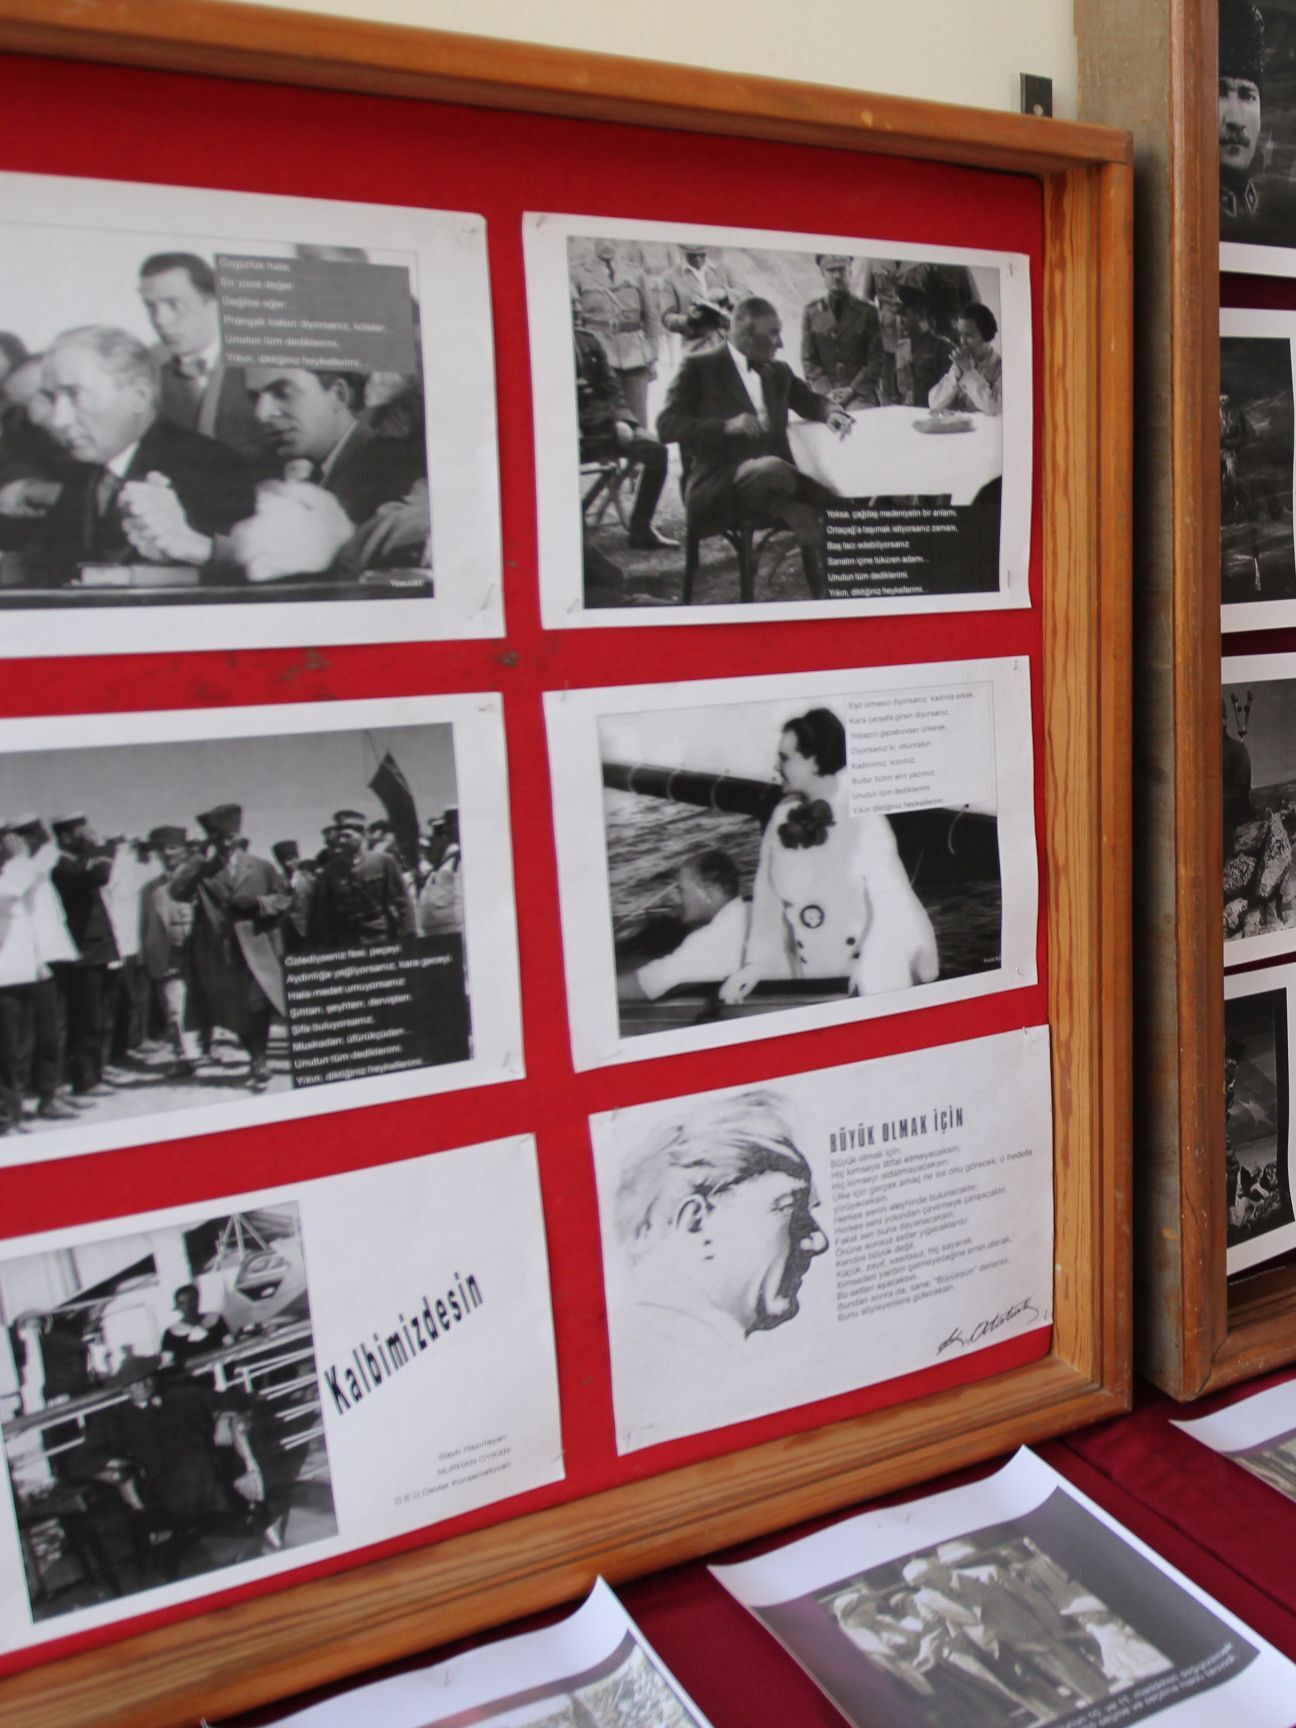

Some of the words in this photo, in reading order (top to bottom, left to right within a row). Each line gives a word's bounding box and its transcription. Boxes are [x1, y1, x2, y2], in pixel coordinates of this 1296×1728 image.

[829, 1122, 875, 1153] BÜYÜK
[882, 1115, 928, 1142] OLMAK
[933, 1105, 964, 1134] İÇİN
[324, 1271, 484, 1416] Kalbimizdesin
